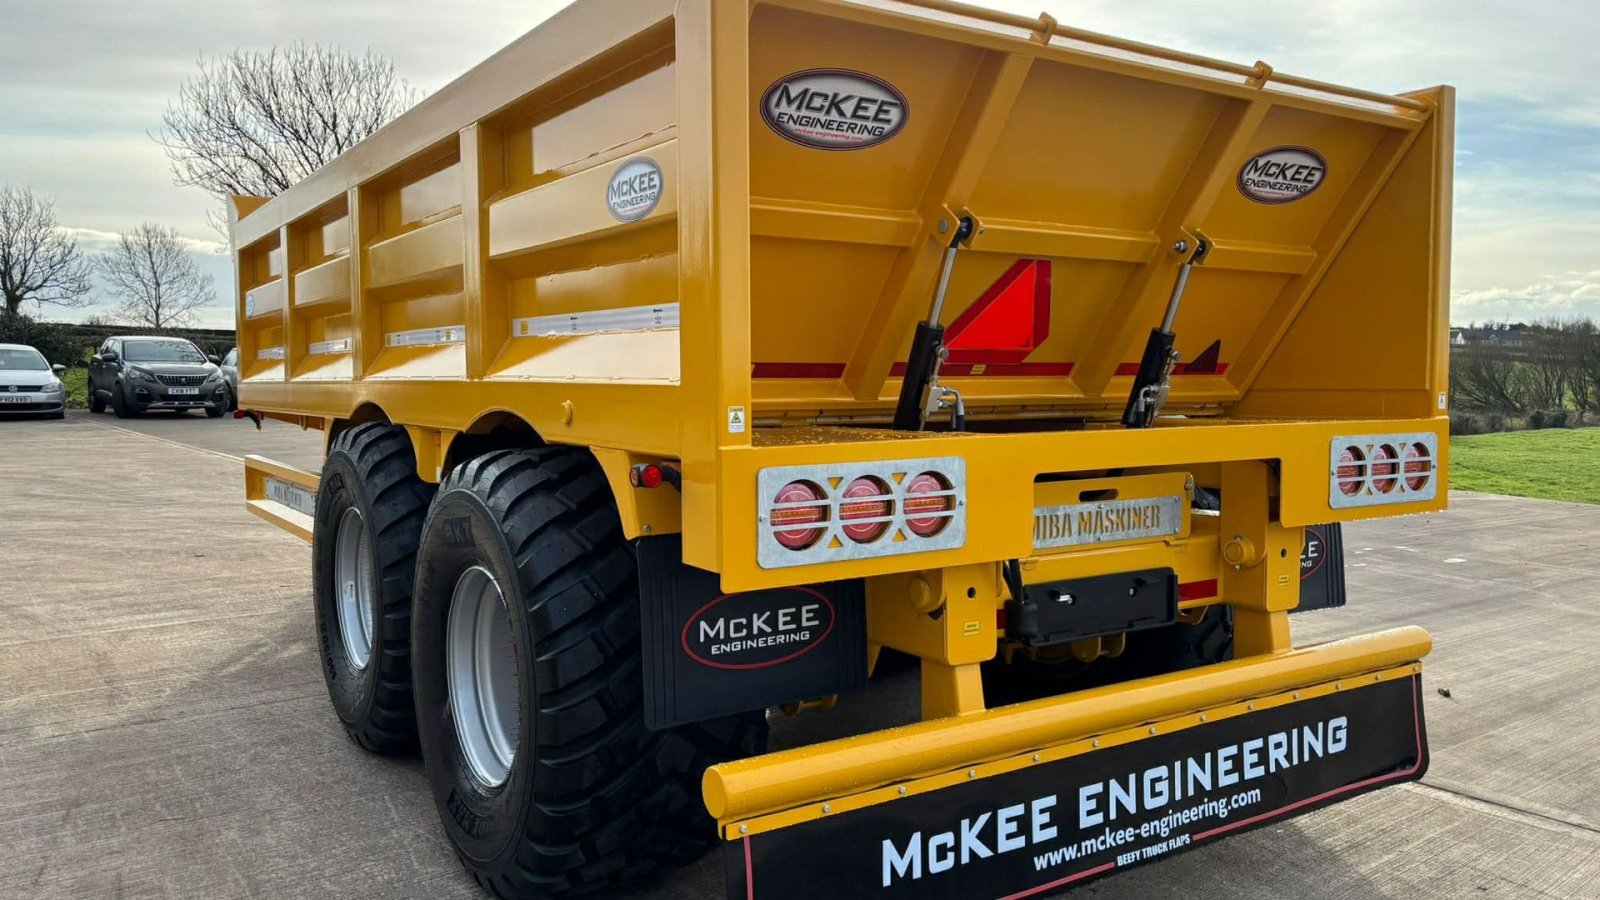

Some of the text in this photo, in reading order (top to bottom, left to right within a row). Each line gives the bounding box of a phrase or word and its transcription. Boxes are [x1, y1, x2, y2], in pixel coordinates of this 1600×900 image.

[775, 112, 885, 137] ENGINEERING
[1244, 178, 1308, 193] ENGINEERING
[612, 191, 656, 210] ENGINEERING
[711, 631, 810, 655] ENGINEERING
[1078, 716, 1348, 829] ENGINEERING
[1033, 788, 1262, 871] www.mckee-engineering.com
[1117, 833, 1191, 867] BEEFY TRUCK FLAPS
